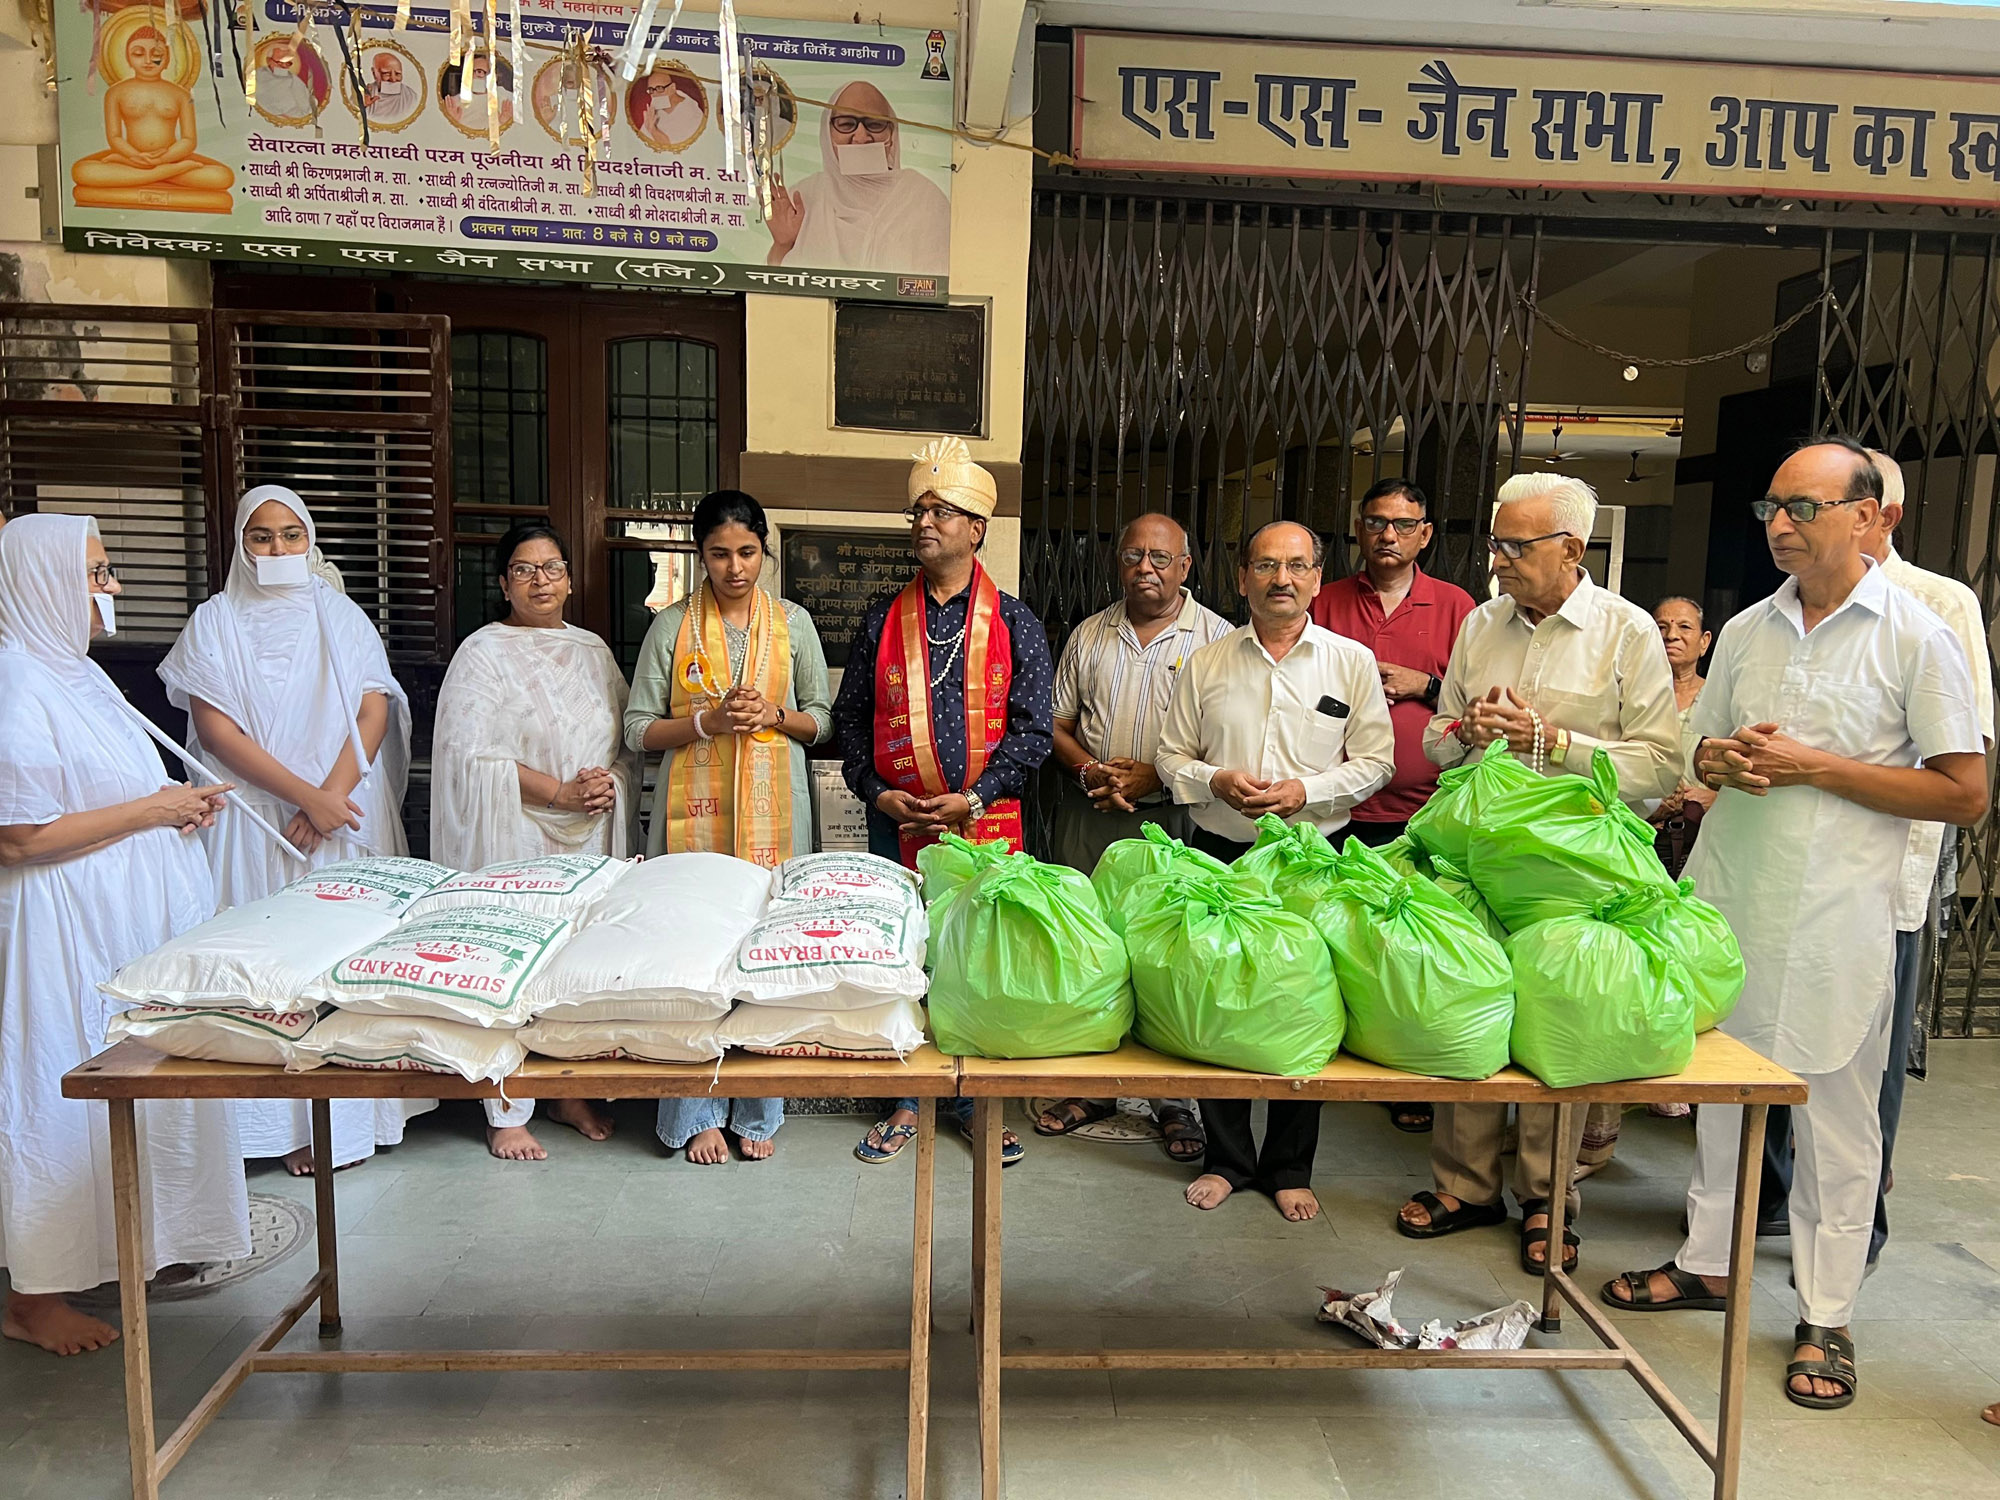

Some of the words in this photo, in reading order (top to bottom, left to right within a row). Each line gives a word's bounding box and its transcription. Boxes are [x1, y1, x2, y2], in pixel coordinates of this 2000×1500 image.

[676, 31, 709, 47] आनंद
[1407, 60, 1517, 158] जैन
[1531, 90, 1681, 181] सभा,
[1705, 96, 1839, 172] आप
[1853, 106, 1936, 177] का
[248, 133, 326, 156] सेवारत्ना
[332, 142, 420, 162] महासाध्वी
[425, 148, 465, 164] परम
[471, 149, 544, 171] पूजनीया
[550, 153, 572, 172] श्री
[249, 160, 282, 178] साध्वी
[286, 161, 300, 179] श्री
[303, 163, 371, 183] किरणप्रभाजी
[425, 171, 456, 188] साध्वी
[460, 171, 474, 189] श्री
[596, 182, 625, 199] साध्वी
[628, 183, 642, 200] श्री
[250, 182, 282, 199] साध्वी
[286, 183, 300, 201] श्री
[426, 192, 457, 209] साध्वी
[461, 193, 475, 210] श्री
[478, 194, 538, 214] वंदिताश्रीजी
[594, 203, 625, 220] साध्वी
[628, 204, 642, 221] श्री
[645, 205, 708, 225] मोक्षदाश्रीजी
[265, 206, 292, 224] आदि
[295, 211, 320, 225] ठाणा
[324, 212, 332, 226] 7
[336, 210, 358, 228] यहाँ
[361, 216, 375, 229] पर
[378, 214, 435, 232] विराजमान
[471, 221, 506, 237] प्रवचन
[511, 223, 538, 238] समय
[593, 227, 604, 241] 8
[609, 228, 629, 243] बजे
[633, 229, 644, 244] से
[650, 230, 661, 244] 9
[666, 231, 685, 246] बजे
[689, 235, 709, 248] तक
[436, 248, 499, 269] जैन
[516, 256, 594, 275] सभा
[745, 269, 886, 292] नवांशहर
[889, 714, 908, 729] जय
[987, 718, 1003, 731] जय
[892, 756, 914, 771] जय
[686, 797, 720, 818] जय
[750, 847, 778, 867] जय
[317, 883, 374, 895] ATTA
[437, 880, 497, 890] BRAN
[501, 879, 566, 890] SURAJ
[415, 942, 480, 954] ATTA
[460, 937, 506, 951] DELICIOUS
[829, 945, 897, 961] SURAJ
[748, 946, 822, 961] BRAND
[348, 959, 425, 982] BRAND
[428, 970, 506, 993] SURAJ
